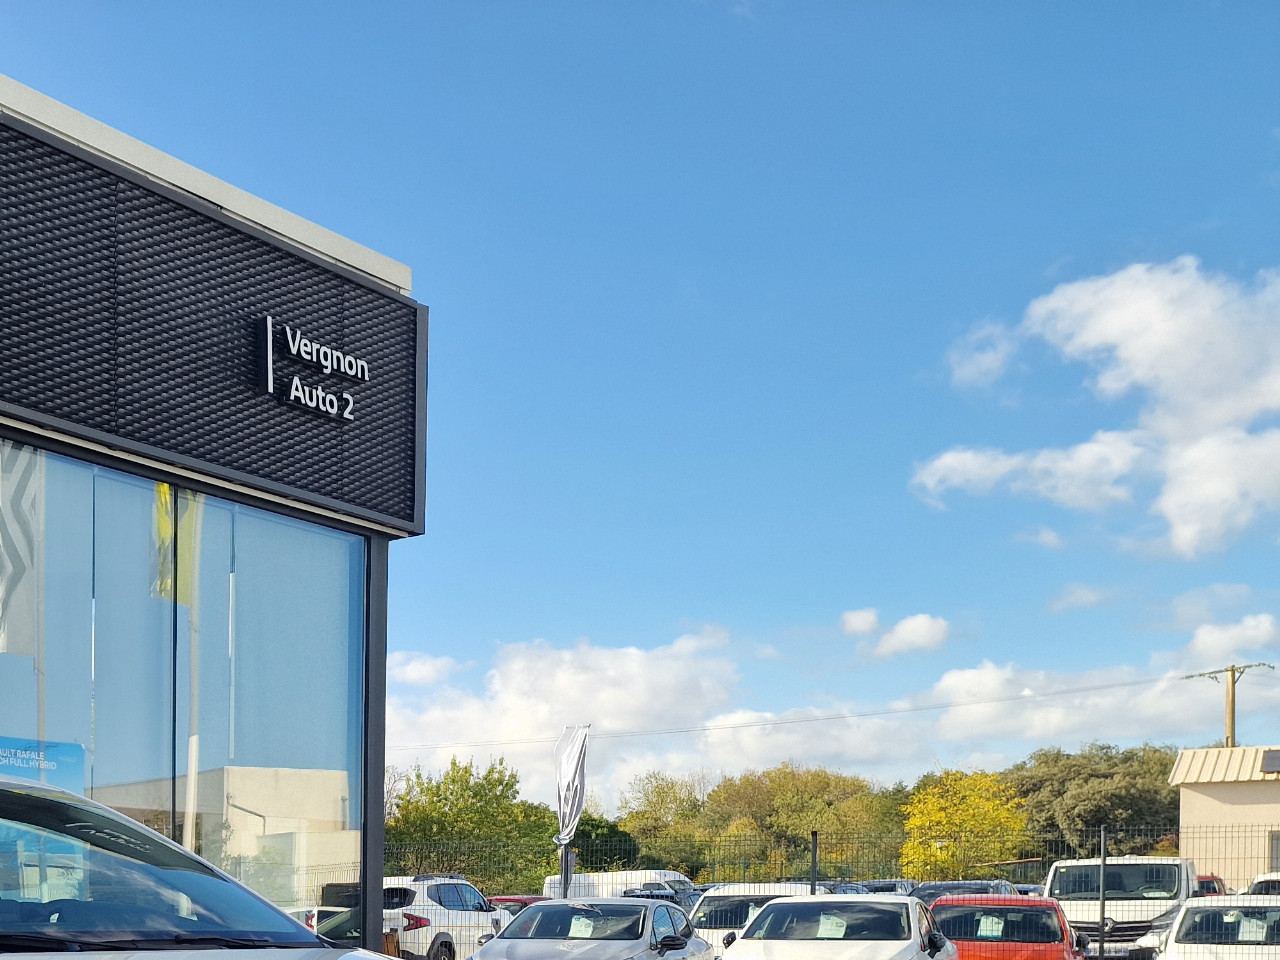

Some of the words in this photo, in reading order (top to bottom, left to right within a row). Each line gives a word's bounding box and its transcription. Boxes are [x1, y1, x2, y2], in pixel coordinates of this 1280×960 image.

[285, 325, 369, 381] Vergnon
[290, 376, 338, 414] Auto
[343, 393, 354, 420] 2
[10, 759, 29, 768] FULL
[29, 760, 57, 770] HYBRID
[16, 750, 45, 760] RAFALE
